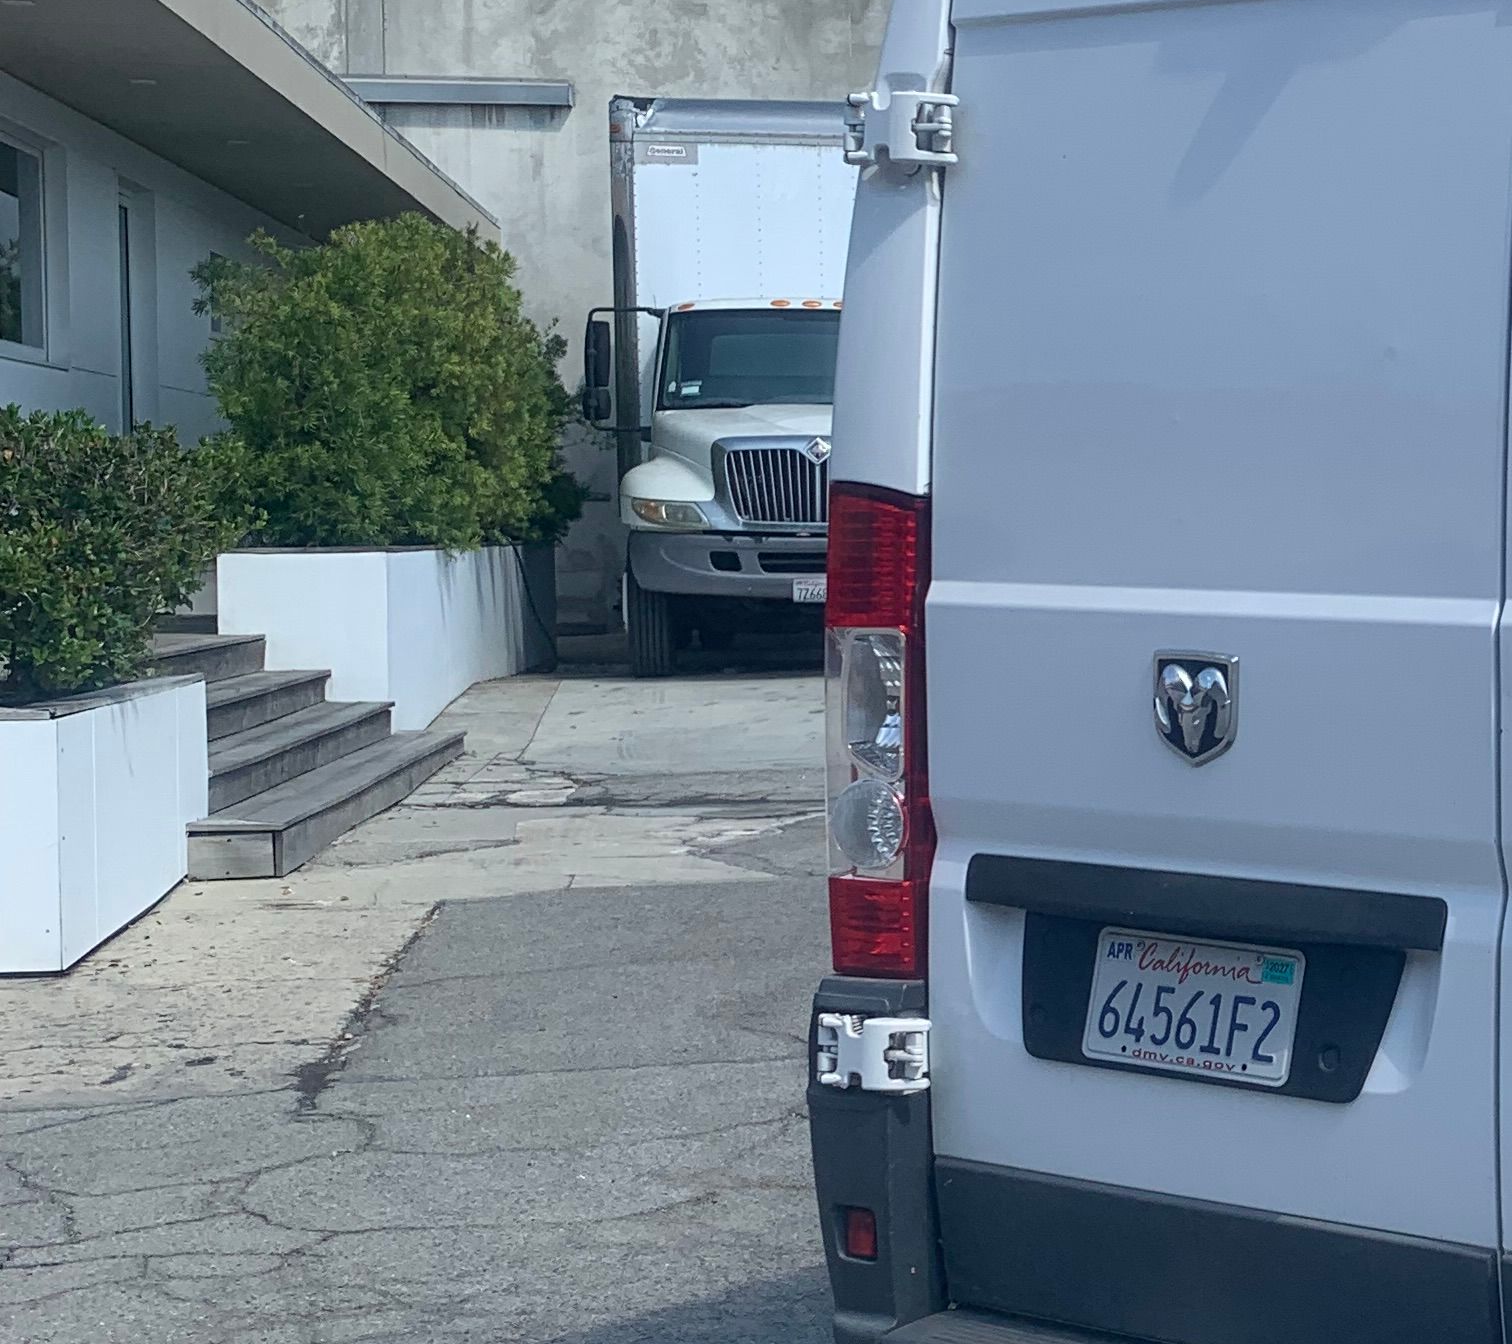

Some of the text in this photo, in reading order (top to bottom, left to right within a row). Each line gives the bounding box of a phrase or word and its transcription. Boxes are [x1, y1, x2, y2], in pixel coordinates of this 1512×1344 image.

[1107, 940, 1134, 961] APR
[1137, 941, 1262, 985] California
[1098, 979, 1281, 1064] 64561F2
[1131, 1047, 1237, 1072] dmv.ca.gov
